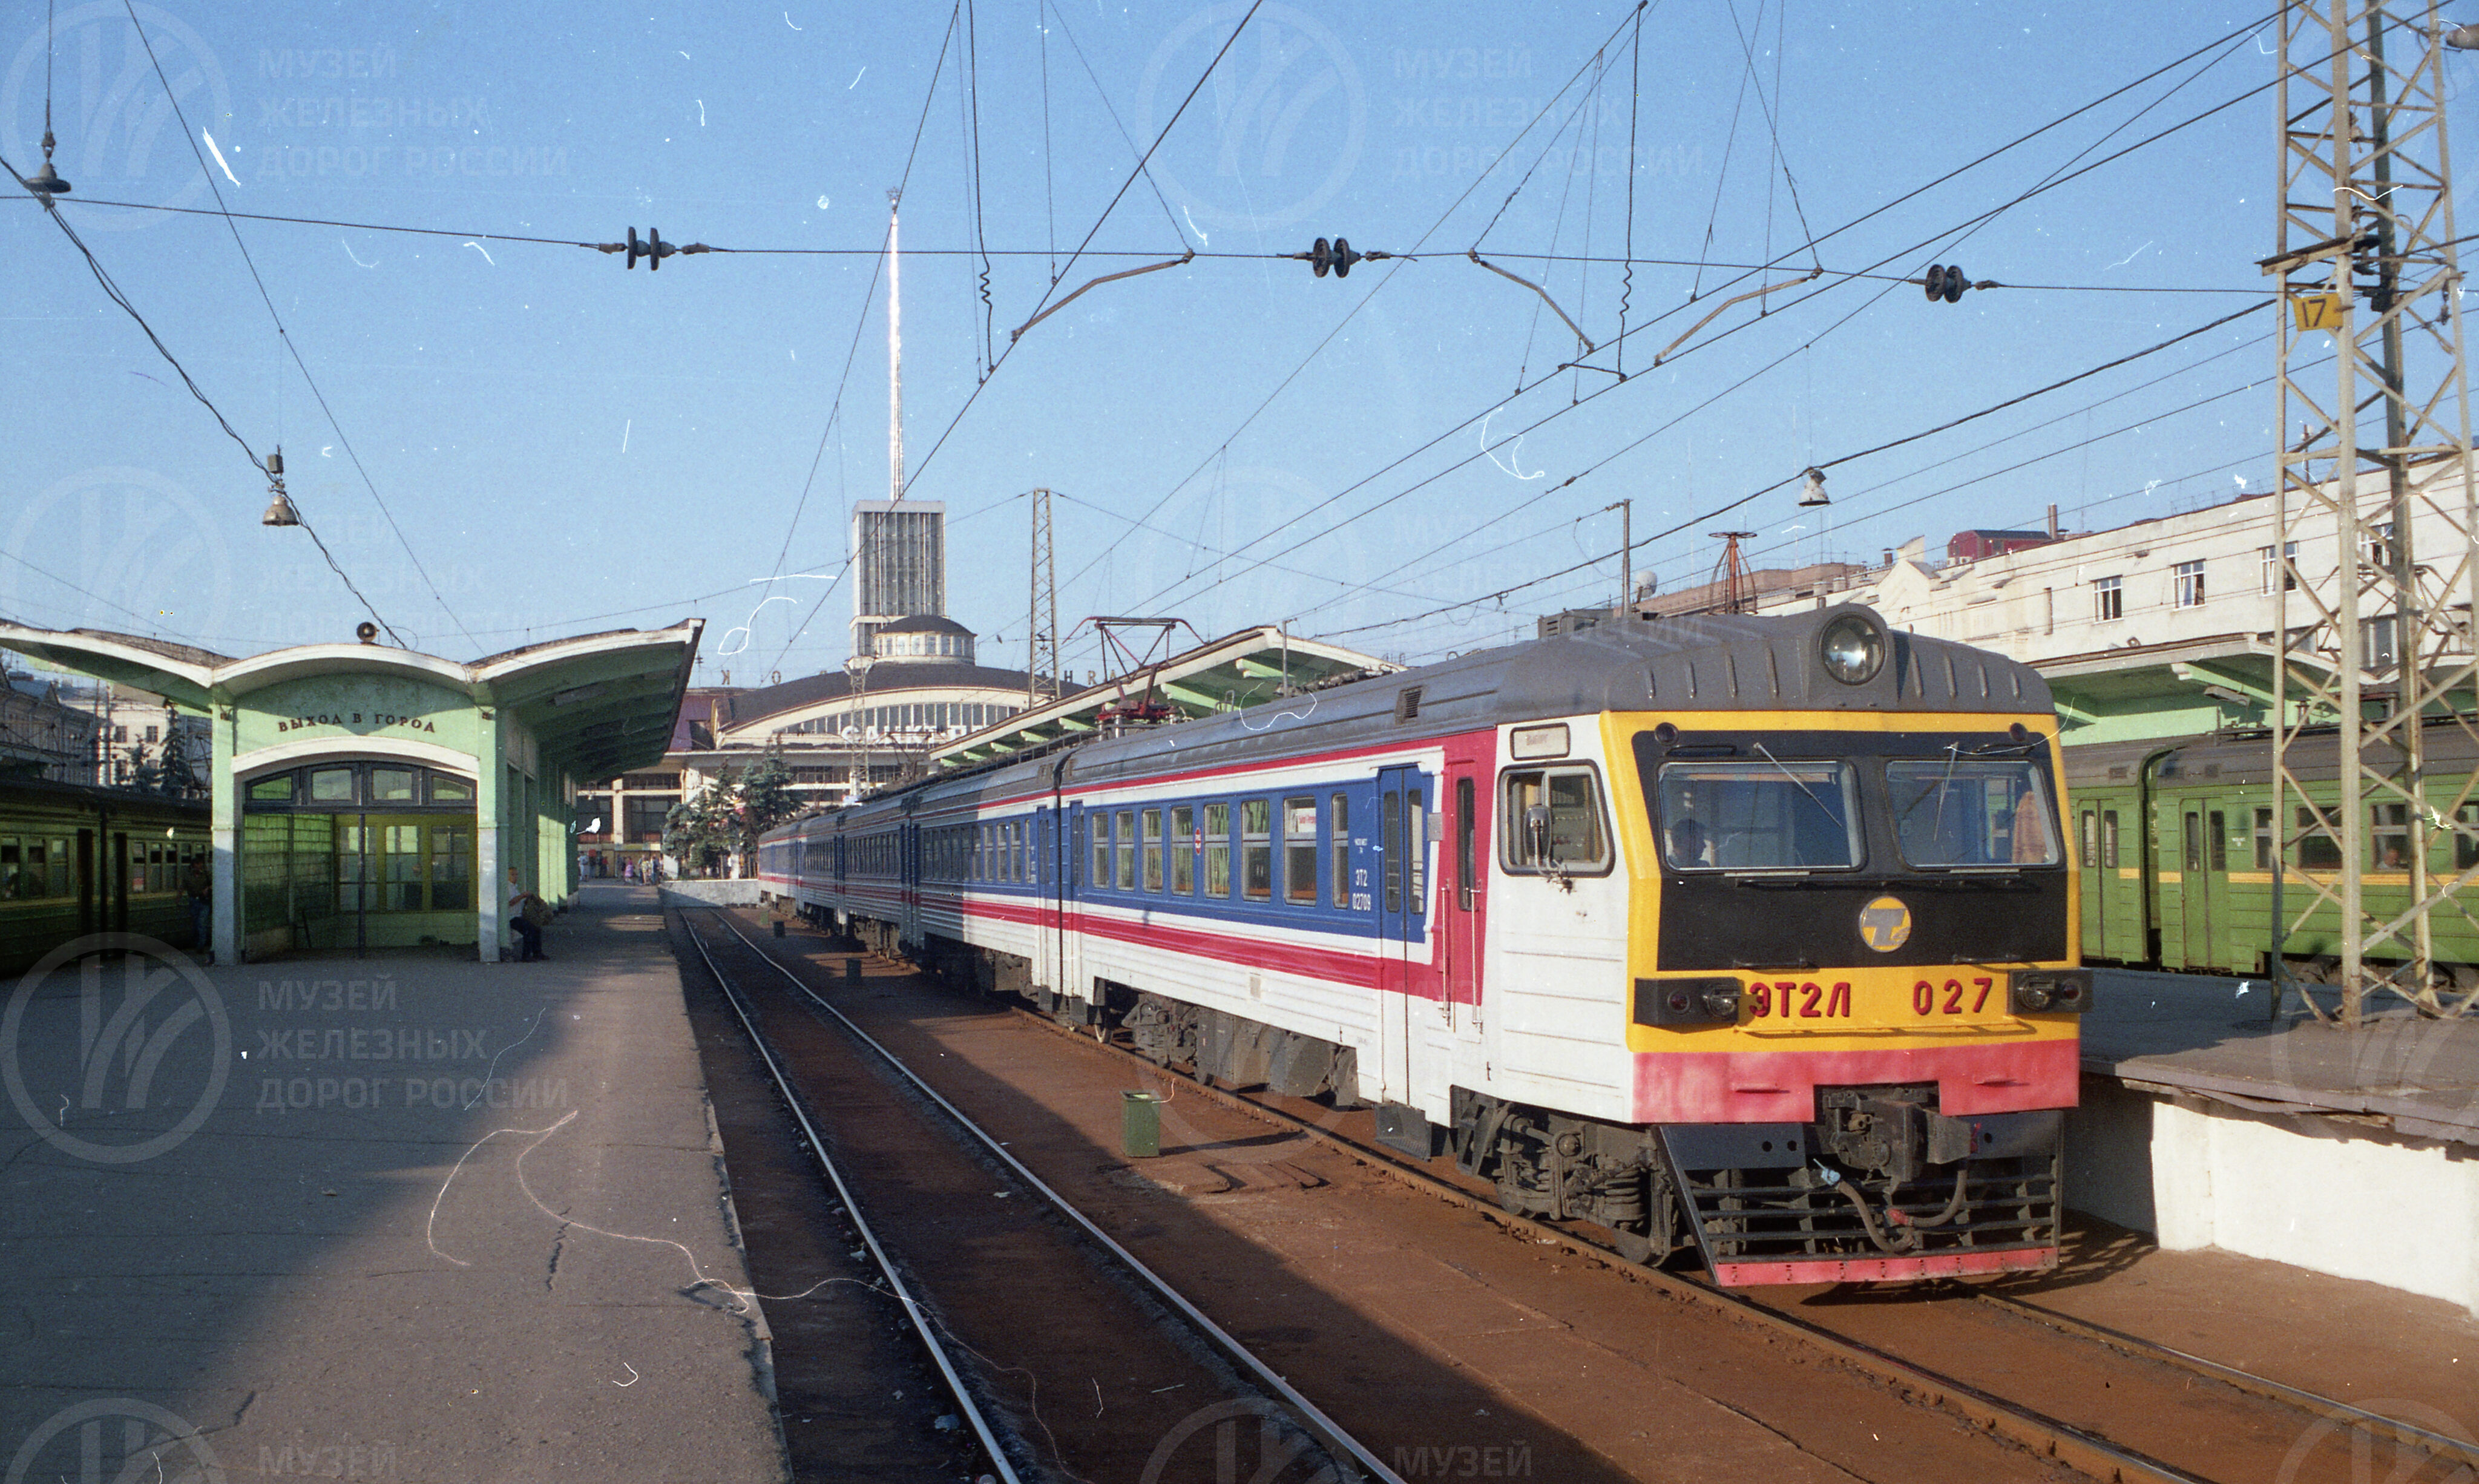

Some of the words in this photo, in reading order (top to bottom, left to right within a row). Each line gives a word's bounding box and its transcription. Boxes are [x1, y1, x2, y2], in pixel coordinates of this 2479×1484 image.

[2302, 298, 2326, 327] 17
[278, 713, 342, 732] ВЫХОД
[353, 713, 362, 723] В
[375, 714, 435, 733] ГОРОД
[1748, 982, 1851, 1018] ЭТ2Л
[1913, 977, 1992, 1016] 027
